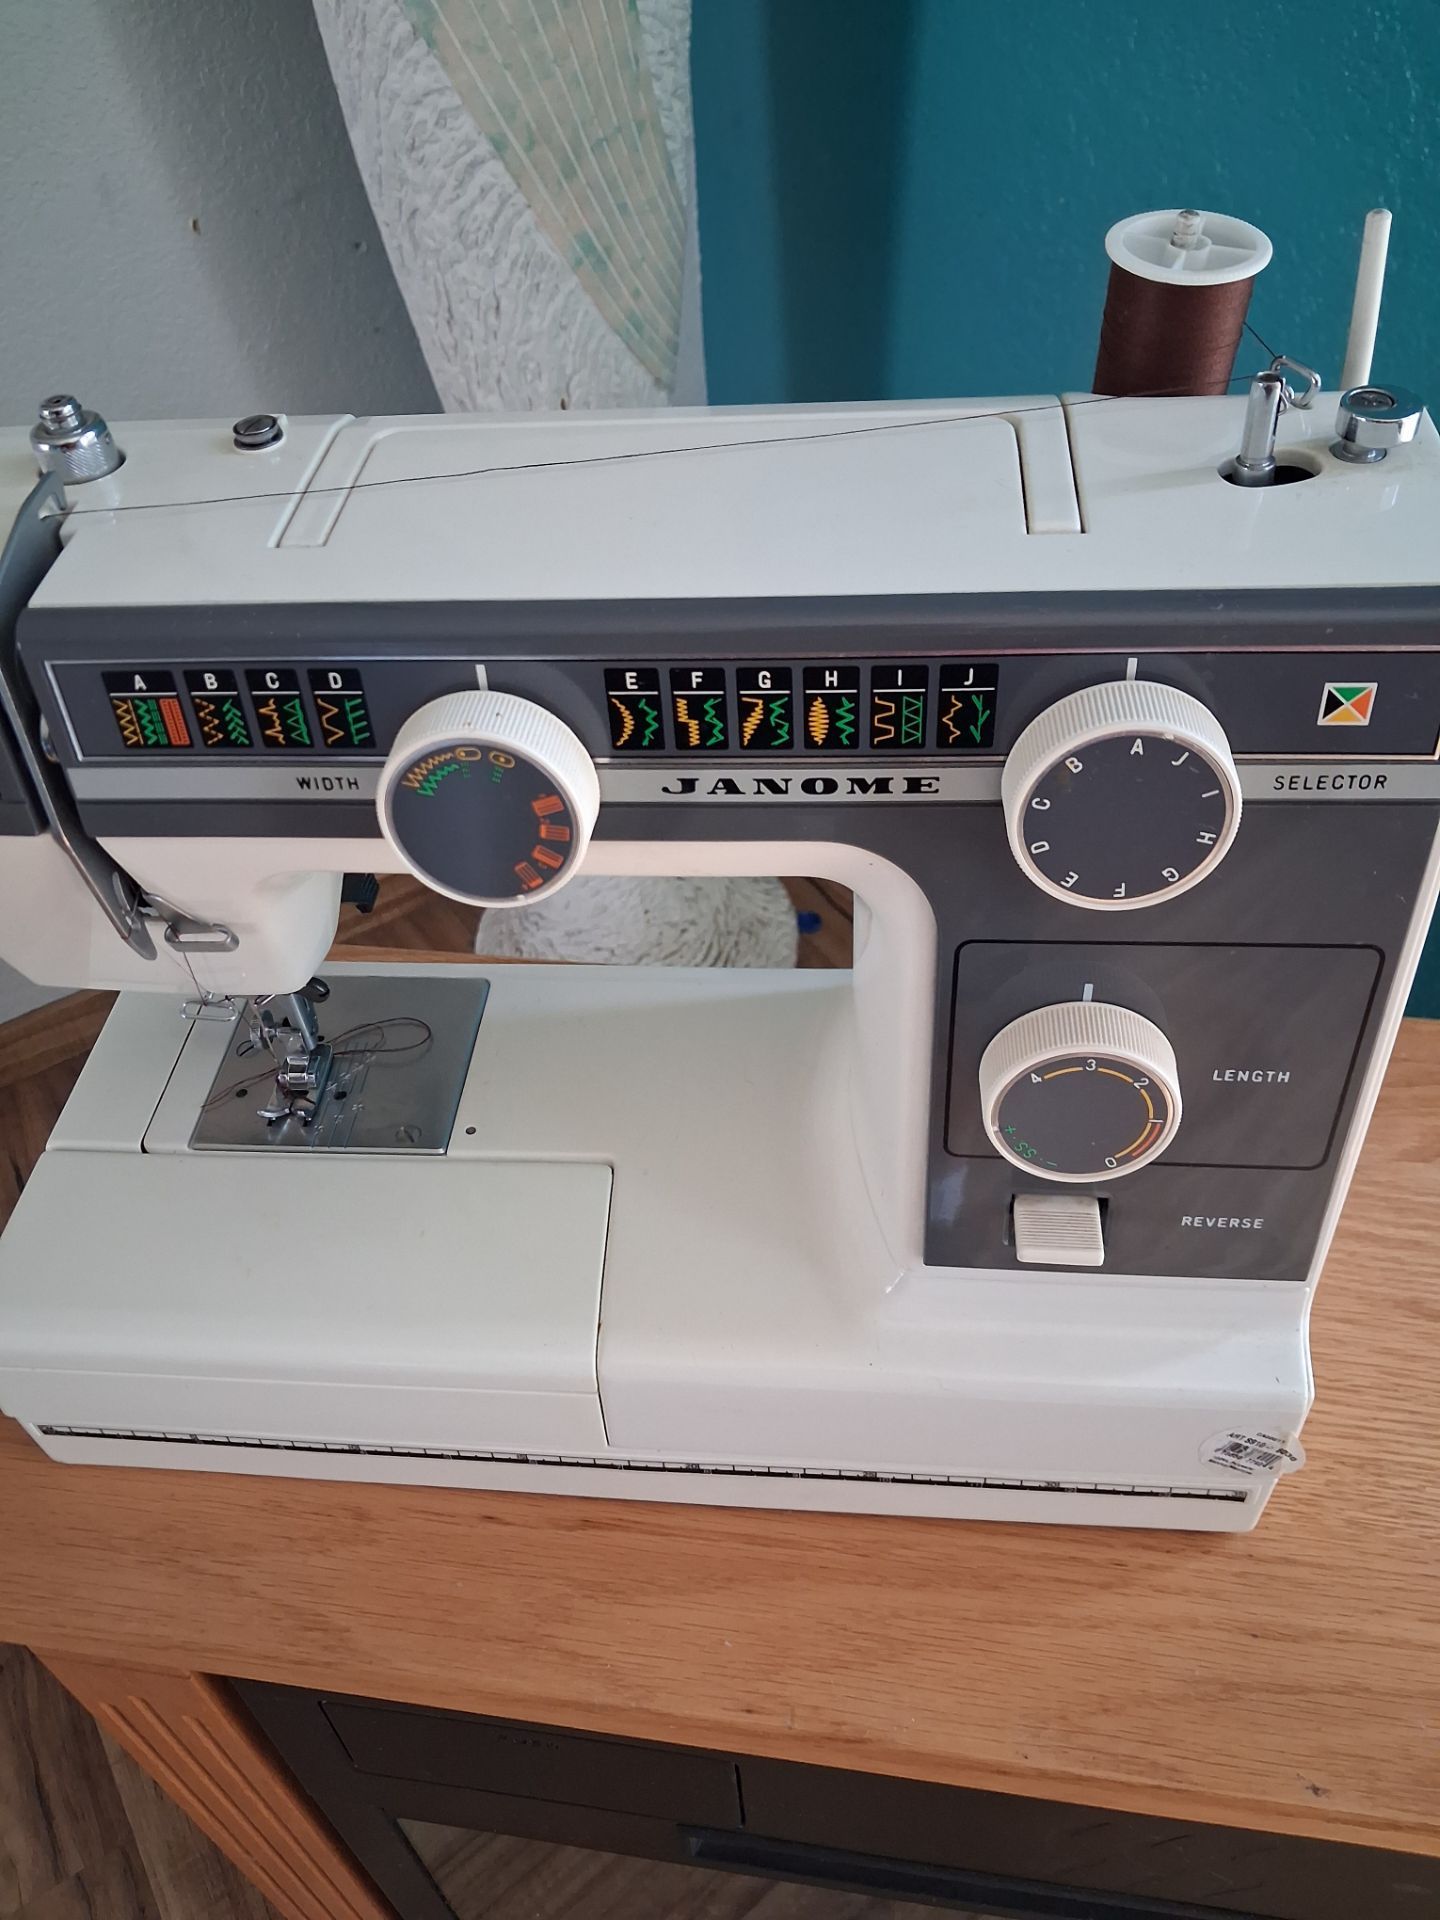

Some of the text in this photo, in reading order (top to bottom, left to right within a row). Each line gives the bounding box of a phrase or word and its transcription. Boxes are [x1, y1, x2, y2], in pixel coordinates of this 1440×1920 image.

[134, 674, 147, 691] A
[203, 673, 218, 690] B
[265, 672, 280, 689] C
[328, 672, 342, 689] D
[625, 671, 638, 690] E
[691, 671, 704, 688] F
[758, 671, 772, 689] G
[825, 670, 838, 688] H
[897, 669, 903, 687] I
[963, 668, 974, 686] J
[1129, 738, 1144, 756] A
[1065, 757, 1083, 774] B
[1171, 752, 1190, 766] J
[296, 777, 360, 791] WIDTH
[661, 777, 941, 796] JANOME
[1273, 774, 1388, 791] SELECTOR
[1031, 797, 1051, 811] C
[1196, 831, 1217, 845] H
[1030, 841, 1050, 855] D
[1060, 871, 1079, 889] E
[1161, 867, 1180, 882] G
[1113, 882, 1126, 898] F
[1085, 1059, 1097, 1071] 3
[1030, 1073, 1042, 1084] 4
[1133, 1077, 1149, 1089] 2
[1212, 1069, 1290, 1083] LENGTH
[1104, 1156, 1117, 1169] 0
[1181, 1216, 1264, 1230] REVERSE
